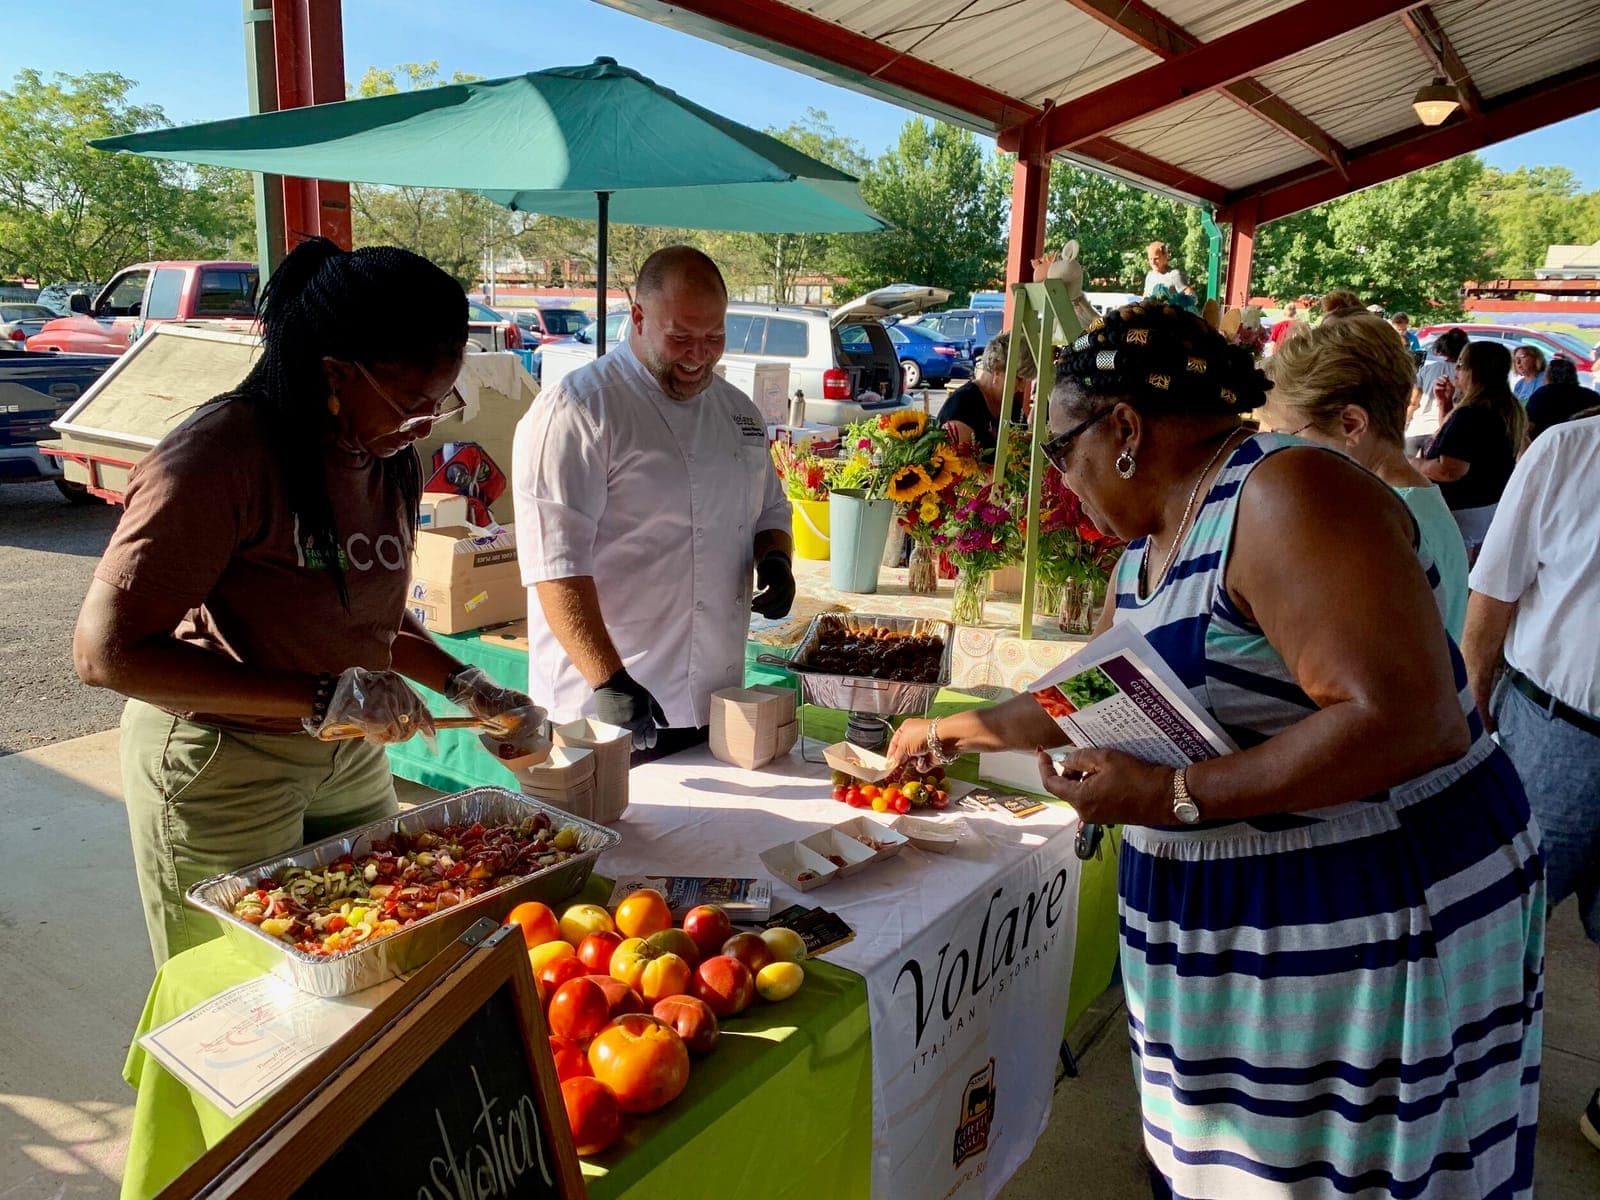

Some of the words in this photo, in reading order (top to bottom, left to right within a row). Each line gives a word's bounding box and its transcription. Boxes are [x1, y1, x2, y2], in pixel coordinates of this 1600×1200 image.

[1129, 680, 1147, 696] GET
[1150, 702, 1174, 724] KINDS
[1130, 692, 1148, 709] FOR
[1152, 716, 1180, 740] LITTLE
[892, 868, 1067, 1049] Volare
[912, 1006, 976, 1074] ITALIAN
